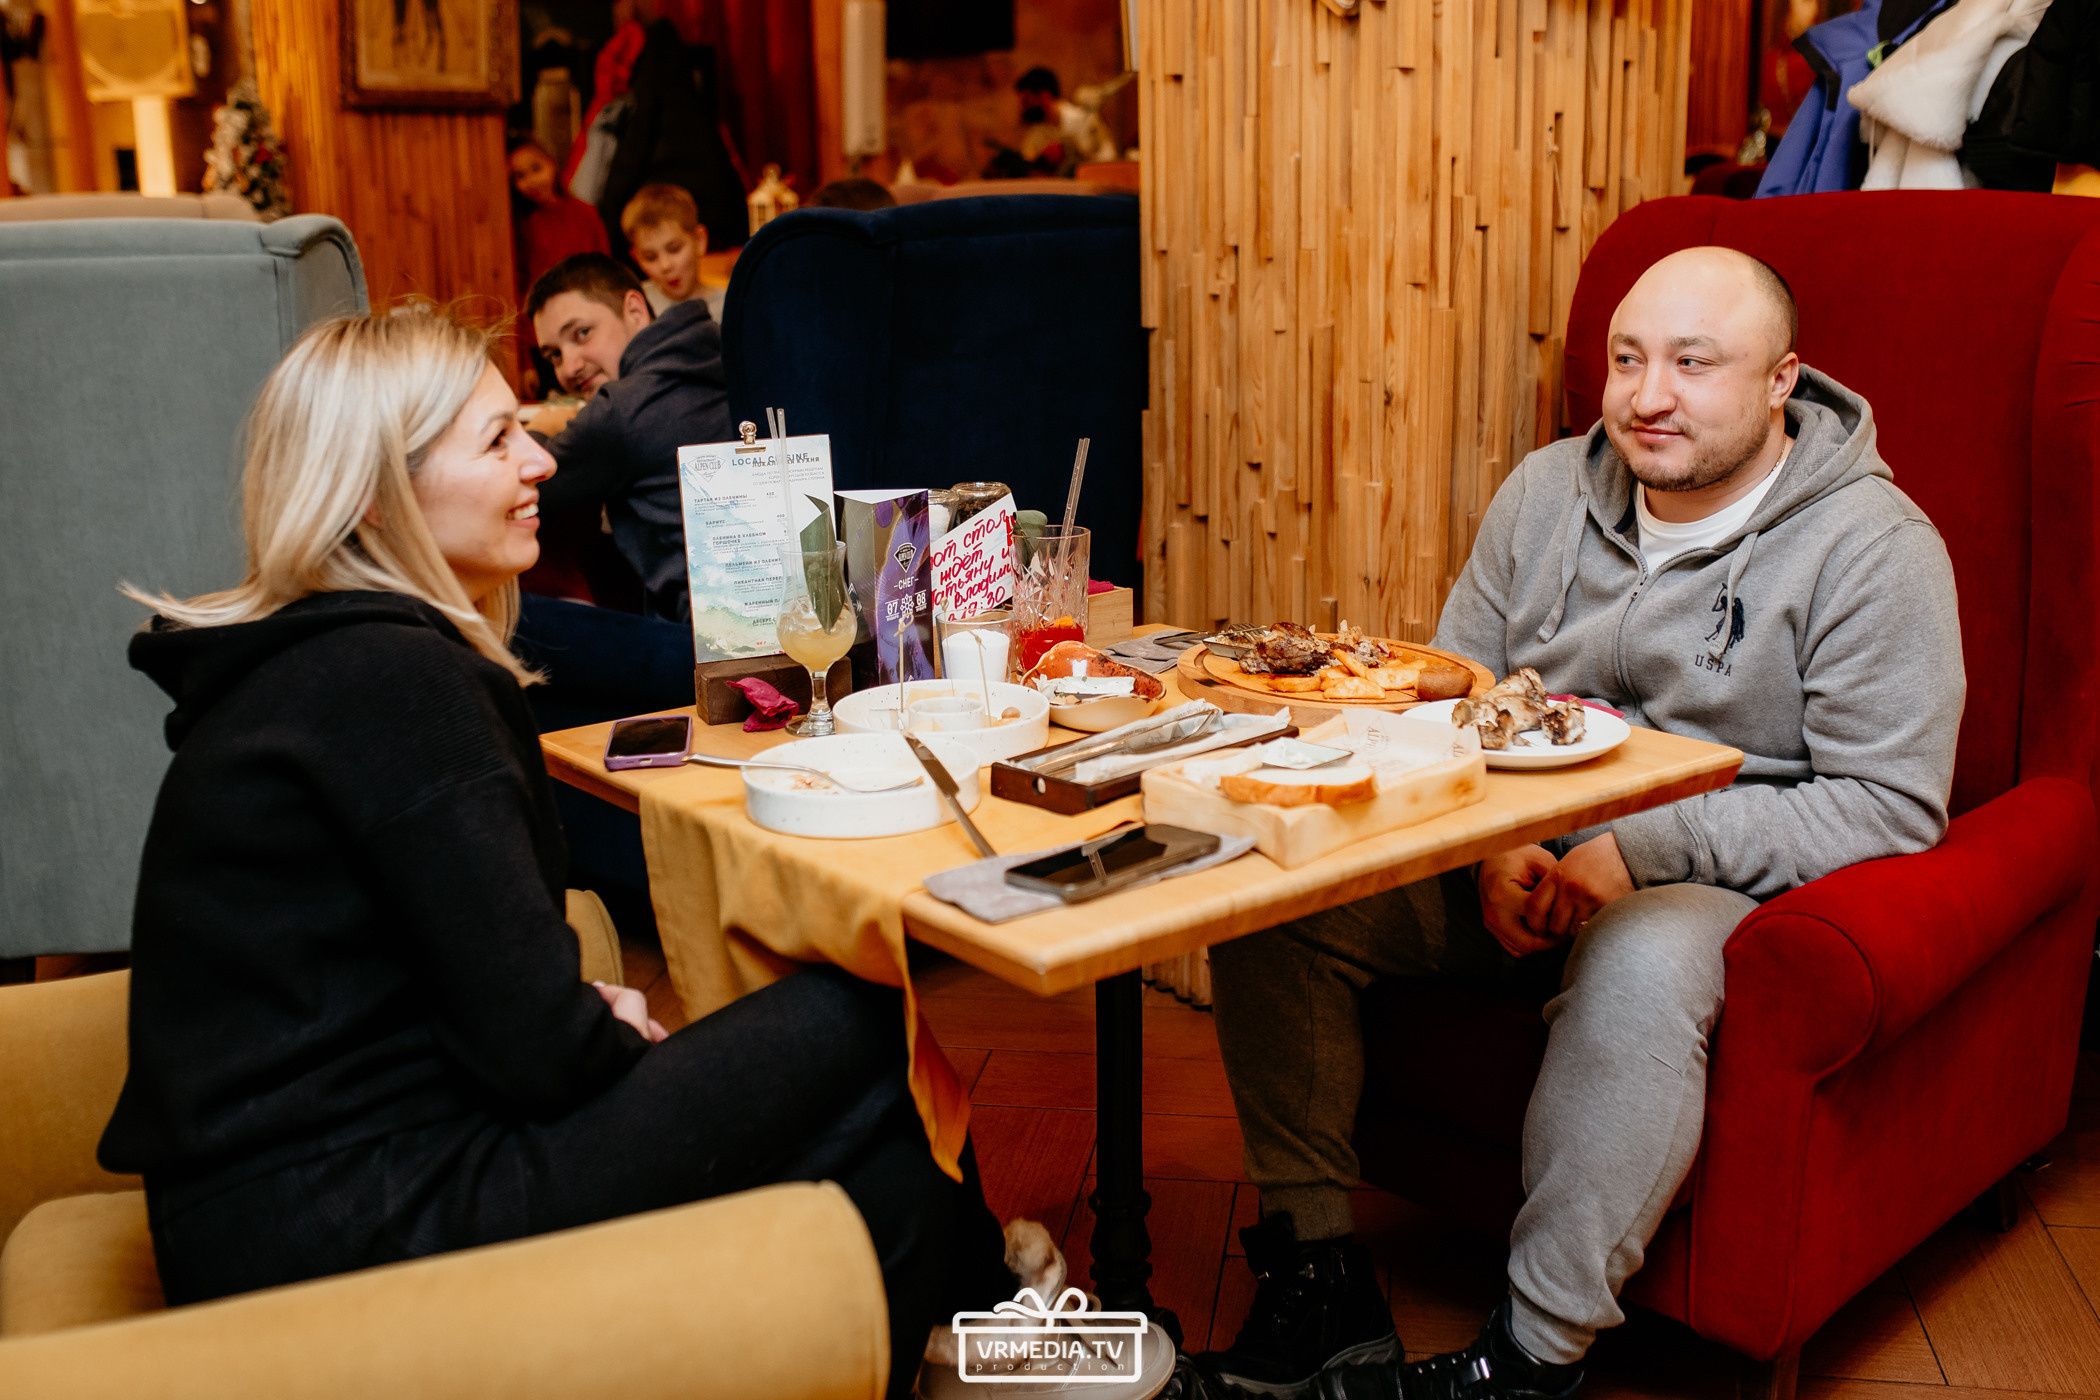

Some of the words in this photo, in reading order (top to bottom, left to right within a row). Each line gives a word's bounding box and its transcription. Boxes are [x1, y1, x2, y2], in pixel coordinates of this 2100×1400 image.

[732, 456, 763, 467] LOCAL
[768, 452, 809, 464] CSINE
[963, 509, 1007, 548] стол
[916, 592, 926, 606] 08
[887, 601, 898, 615] 07
[1695, 655, 1732, 677] USPA
